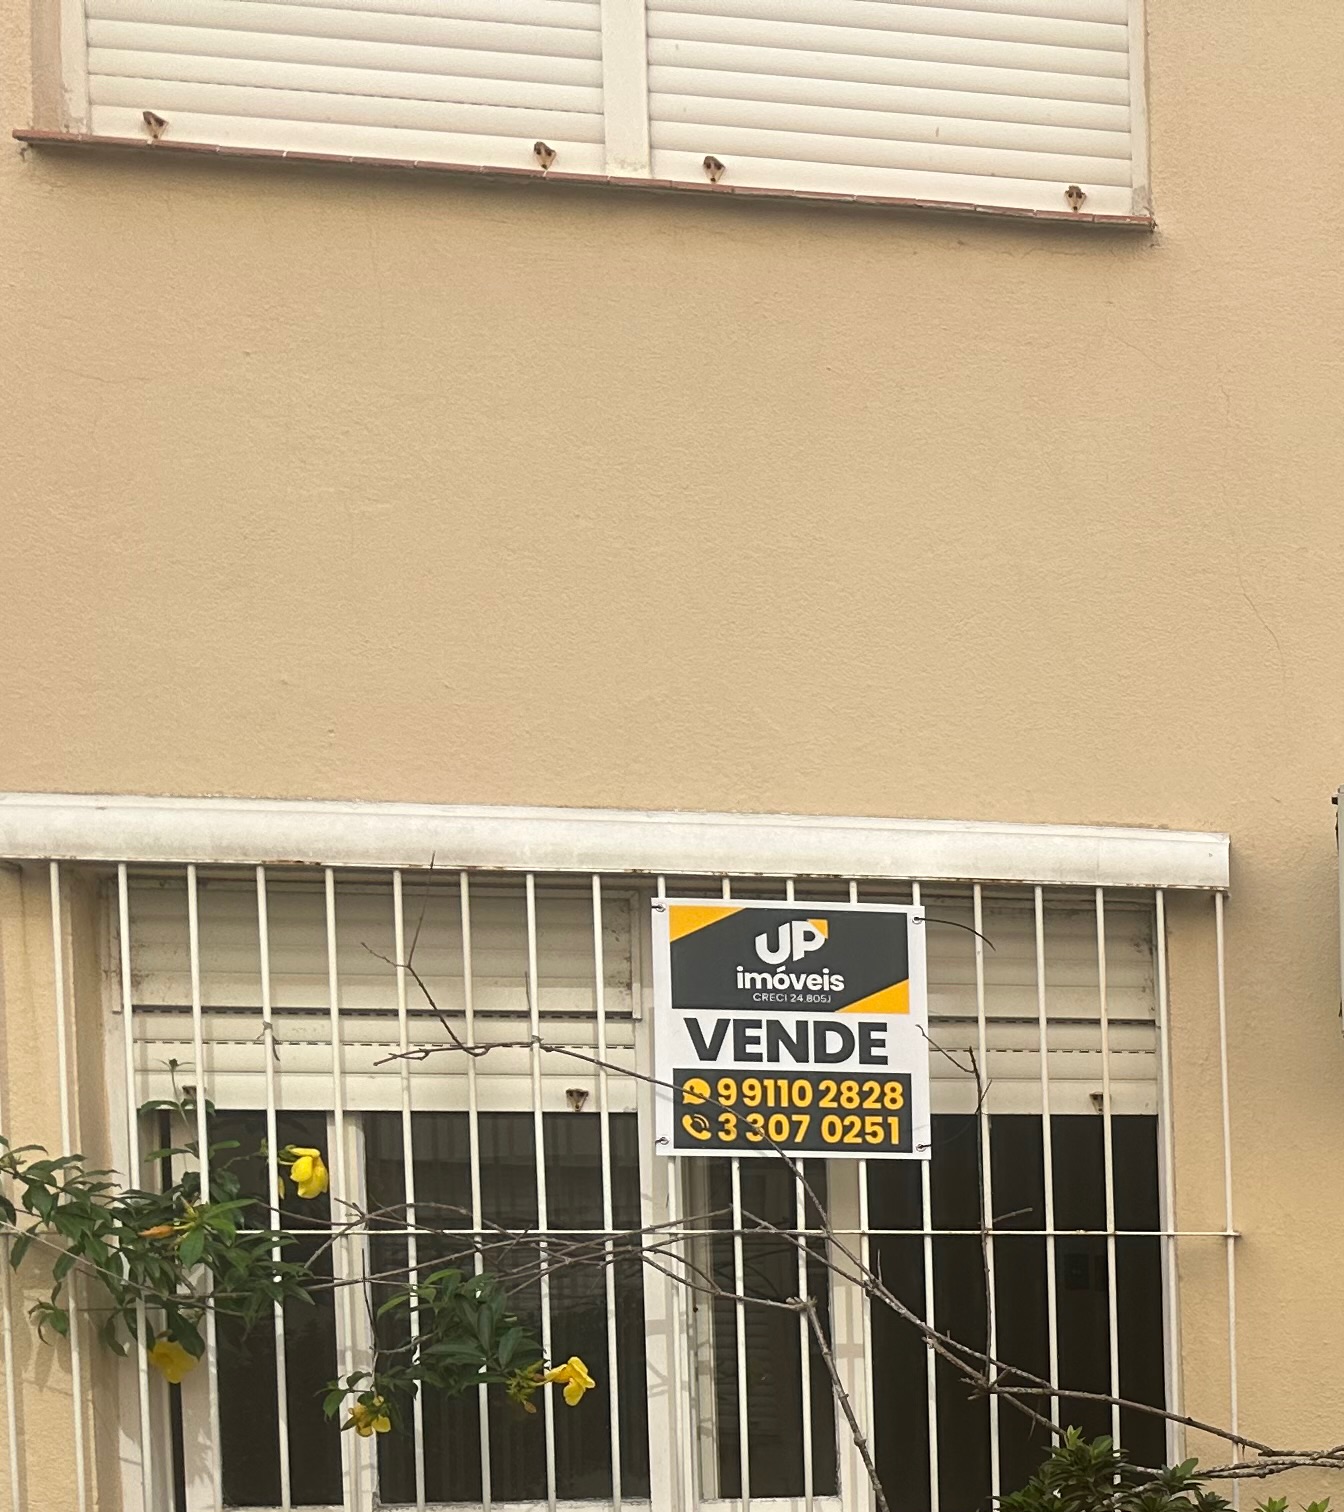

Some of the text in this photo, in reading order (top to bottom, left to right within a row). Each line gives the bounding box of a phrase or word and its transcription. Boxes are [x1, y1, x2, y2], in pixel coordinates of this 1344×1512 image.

[755, 918, 828, 965] UP
[736, 966, 845, 992] imóveis
[752, 992, 788, 1003] CRECI
[683, 1017, 889, 1066] VENDE
[818, 1080, 905, 1110] 2828
[821, 1115, 900, 1145] 0251
